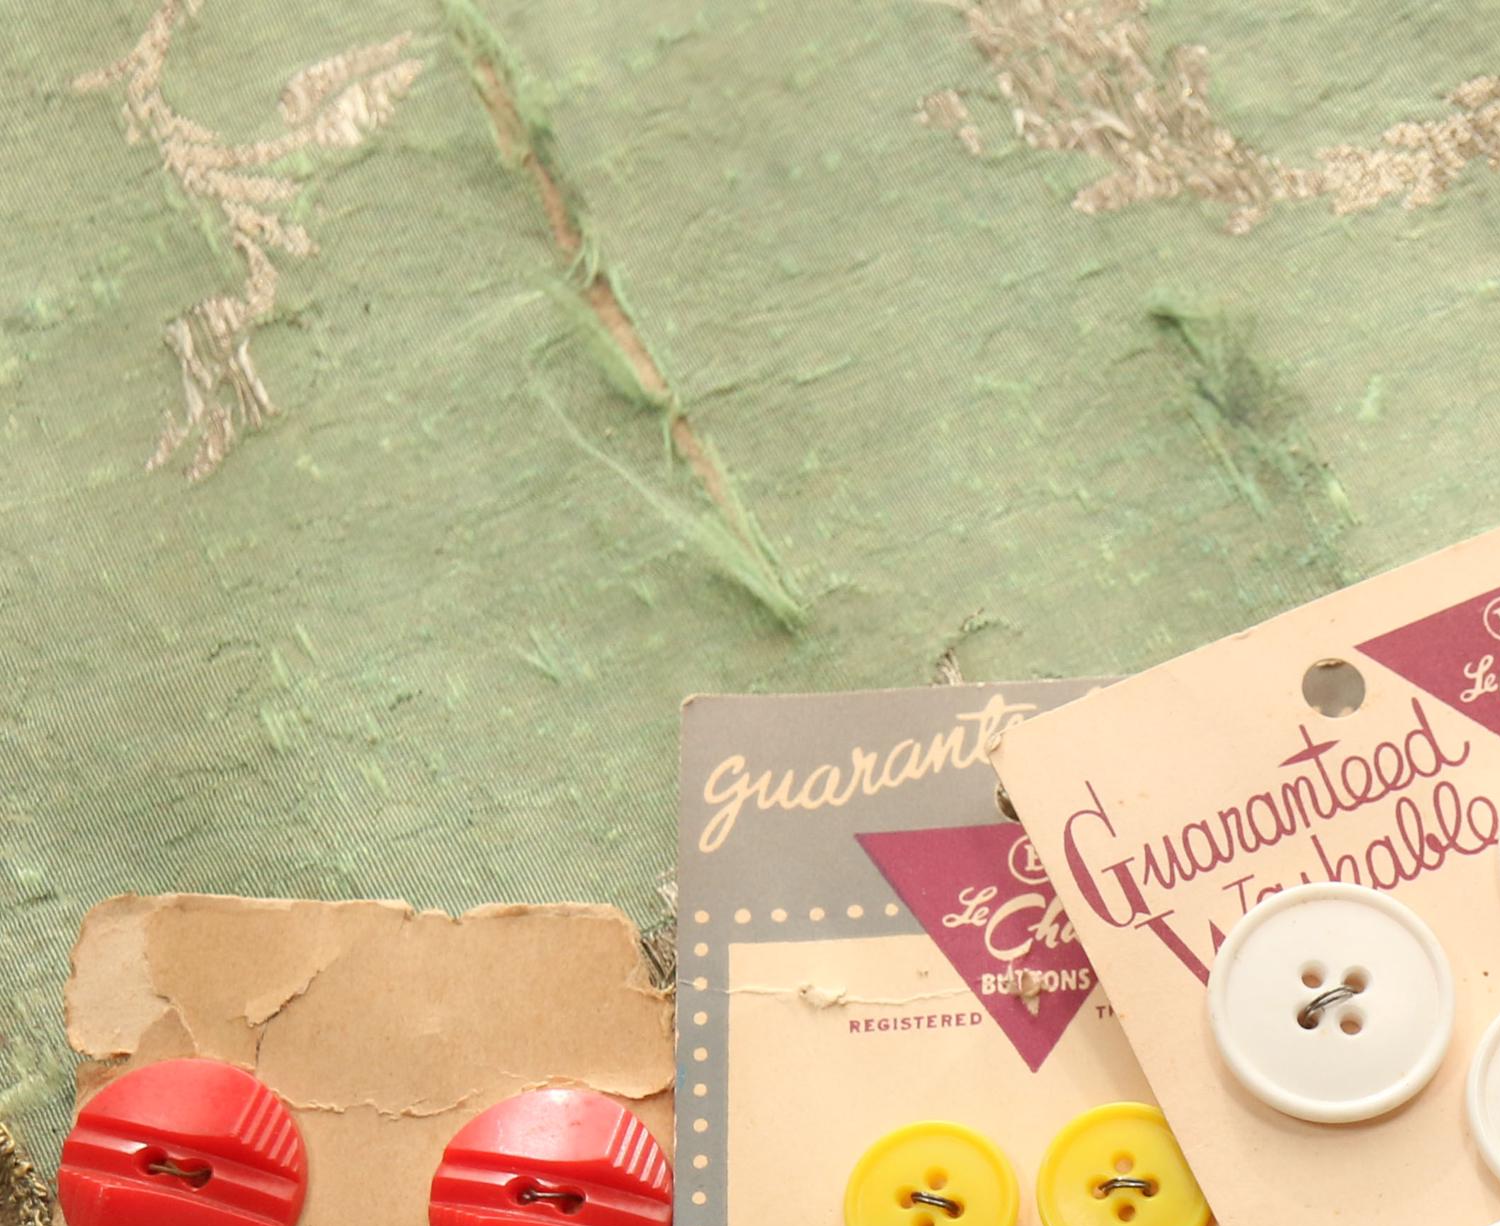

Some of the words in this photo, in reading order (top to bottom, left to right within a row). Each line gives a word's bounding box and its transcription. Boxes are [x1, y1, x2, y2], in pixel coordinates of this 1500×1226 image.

[1460, 654, 1498, 702] Le
[1063, 697, 1470, 928] Guaranteed
[942, 886, 998, 928] Le
[849, 1012, 983, 1034] REGISTERED
